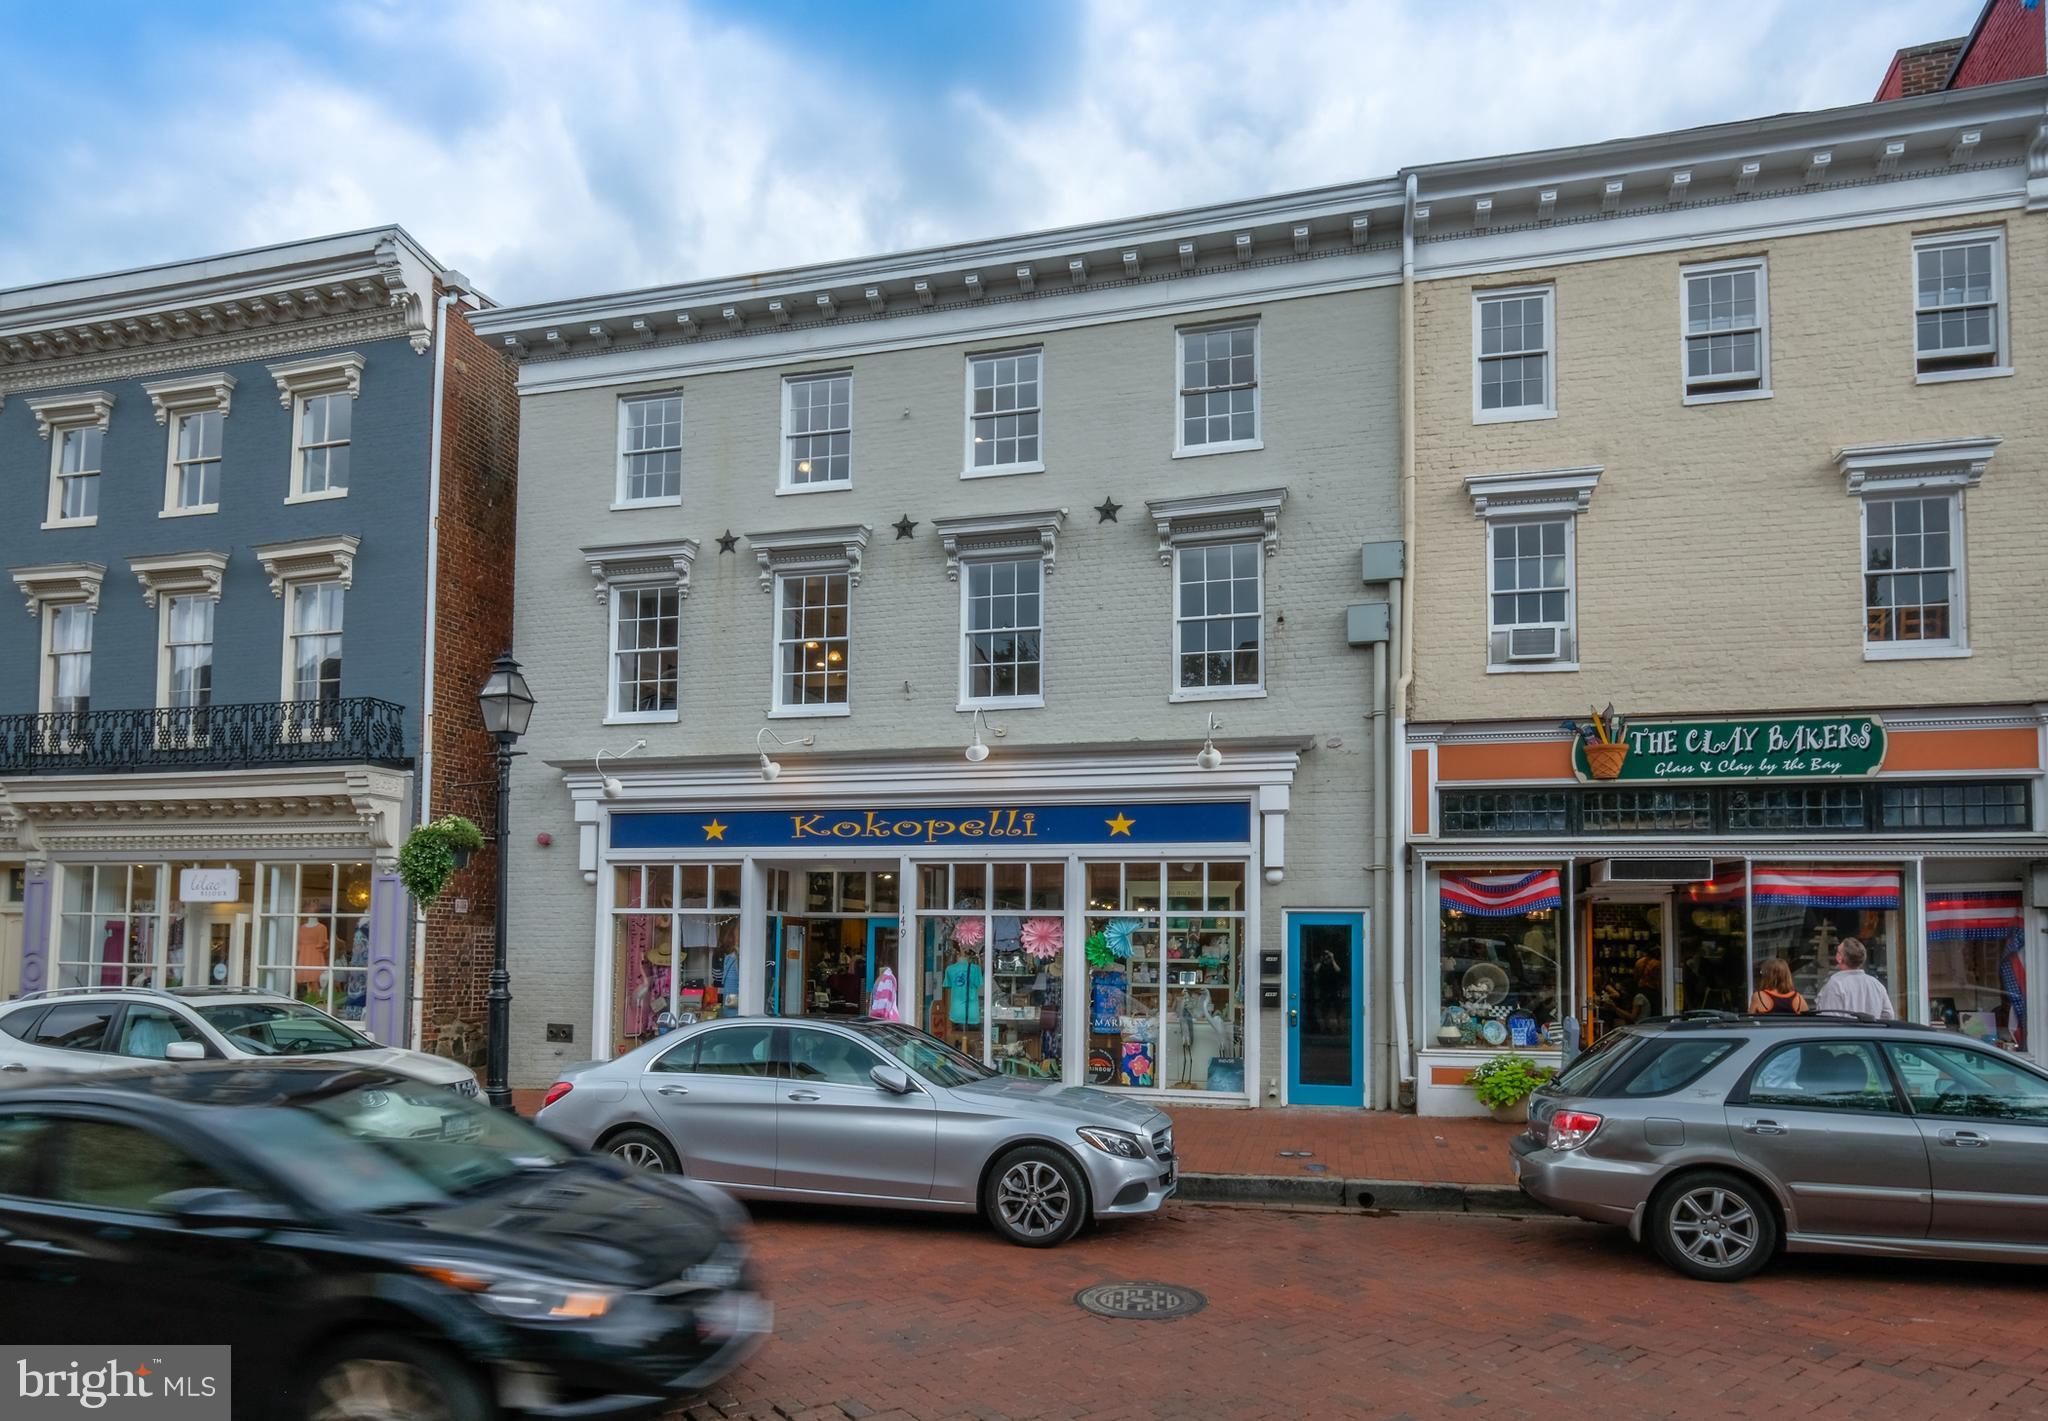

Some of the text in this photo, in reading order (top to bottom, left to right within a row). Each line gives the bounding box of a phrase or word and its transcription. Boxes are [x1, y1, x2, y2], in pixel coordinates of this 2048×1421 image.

[1630, 722, 1872, 756] THE CLAY BAKERS
[1654, 761, 1695, 776] Glass
[1717, 759, 1754, 776] Clay
[1759, 758, 1778, 775] by
[1783, 757, 1807, 771] the
[1810, 757, 1842, 773] Bay
[790, 810, 1038, 843] Kokopelli
[190, 874, 219, 891] lilac
